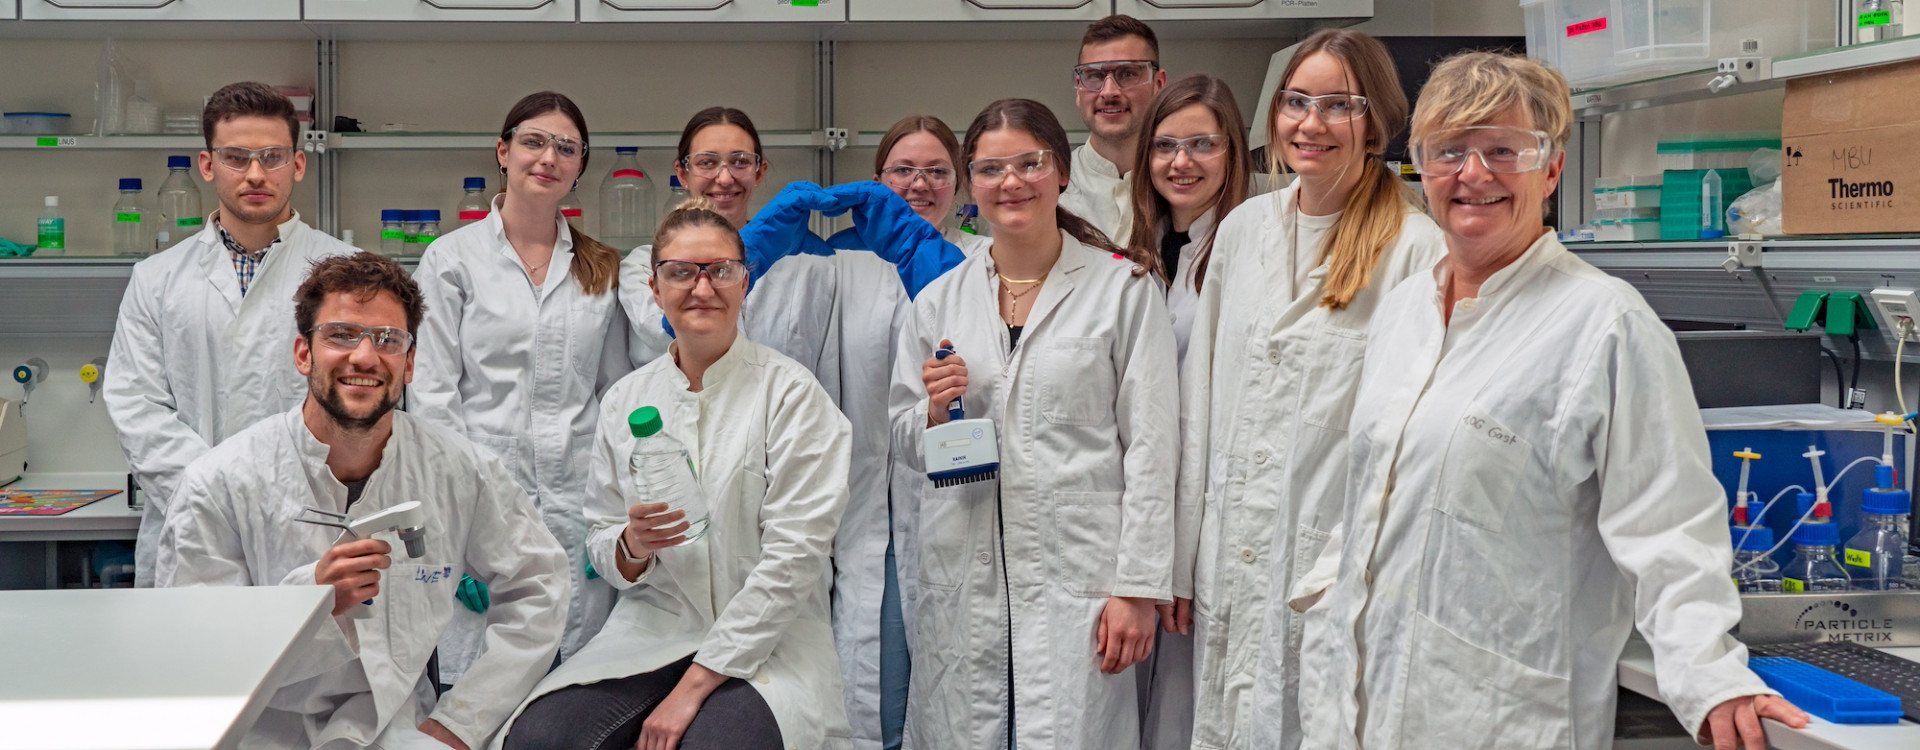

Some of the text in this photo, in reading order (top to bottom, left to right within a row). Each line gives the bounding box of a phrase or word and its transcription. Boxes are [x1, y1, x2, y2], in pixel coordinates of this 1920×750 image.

[1832, 145, 1872, 172] MBU
[1828, 178, 1894, 198] Thermo
[1831, 200, 1893, 210] SCIENTIFIC
[1804, 619, 1893, 630] PARTICLE
[1828, 632, 1892, 642] METRIX
